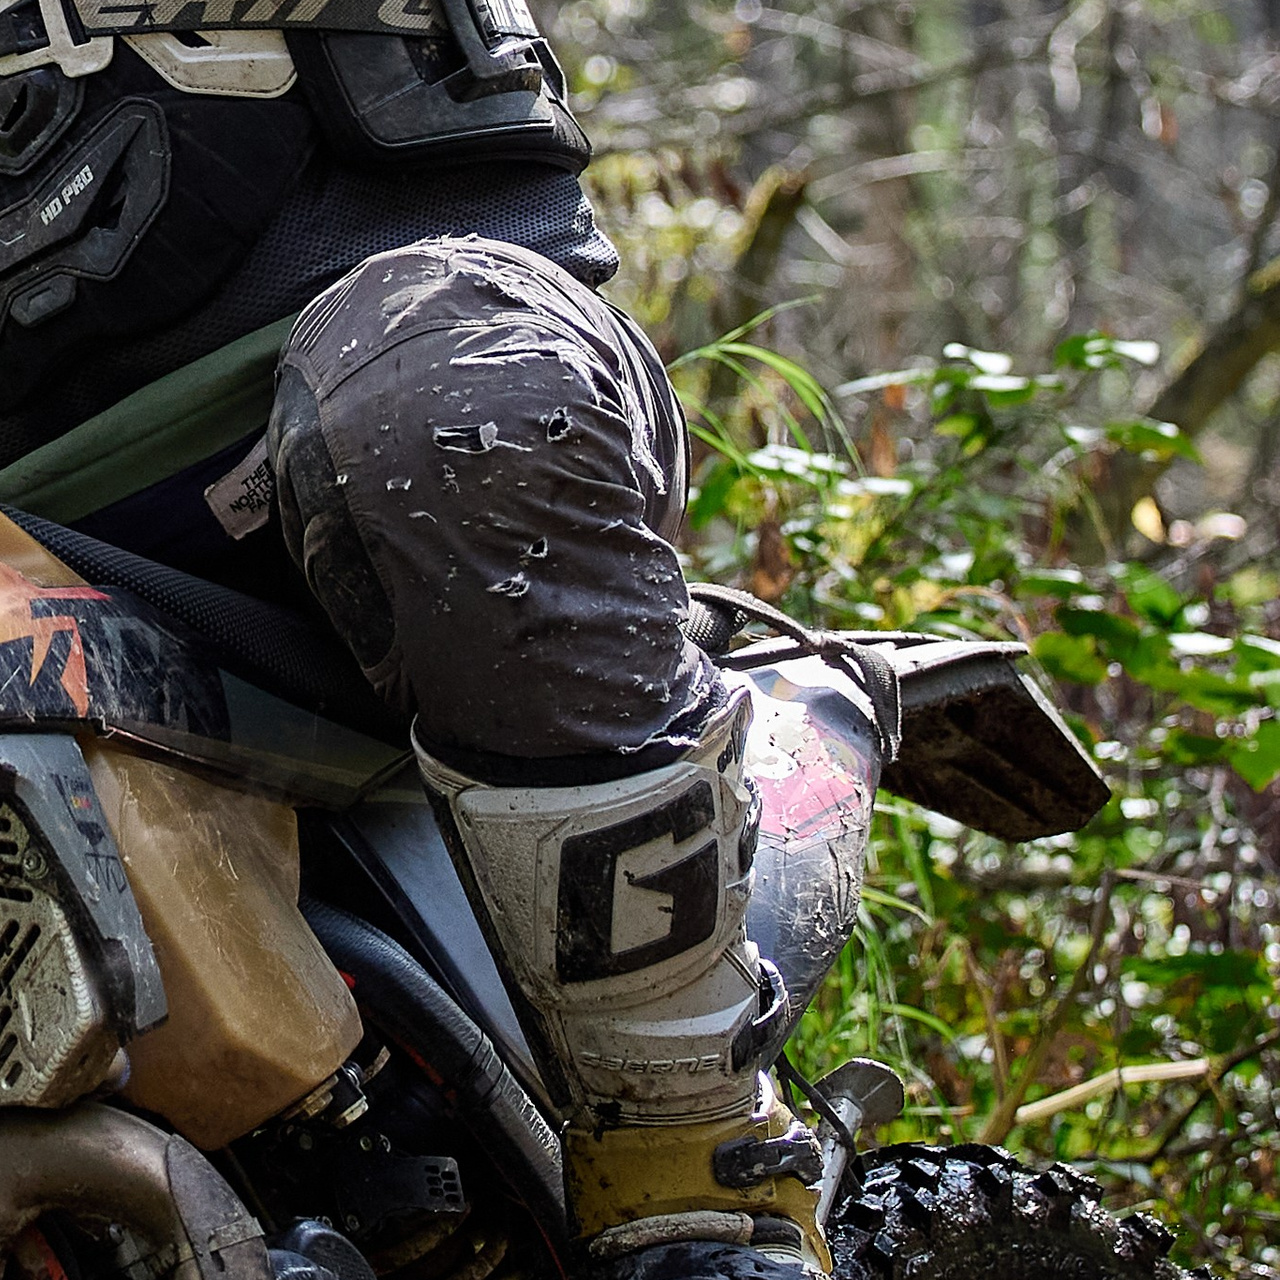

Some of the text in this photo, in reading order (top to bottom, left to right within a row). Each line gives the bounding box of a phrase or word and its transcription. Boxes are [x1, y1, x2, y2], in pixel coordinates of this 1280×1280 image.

[40, 165, 94, 226] HD PRO
[241, 464, 267, 490] THE
[229, 474, 274, 513] NORTH
[248, 490, 272, 514] FAC
